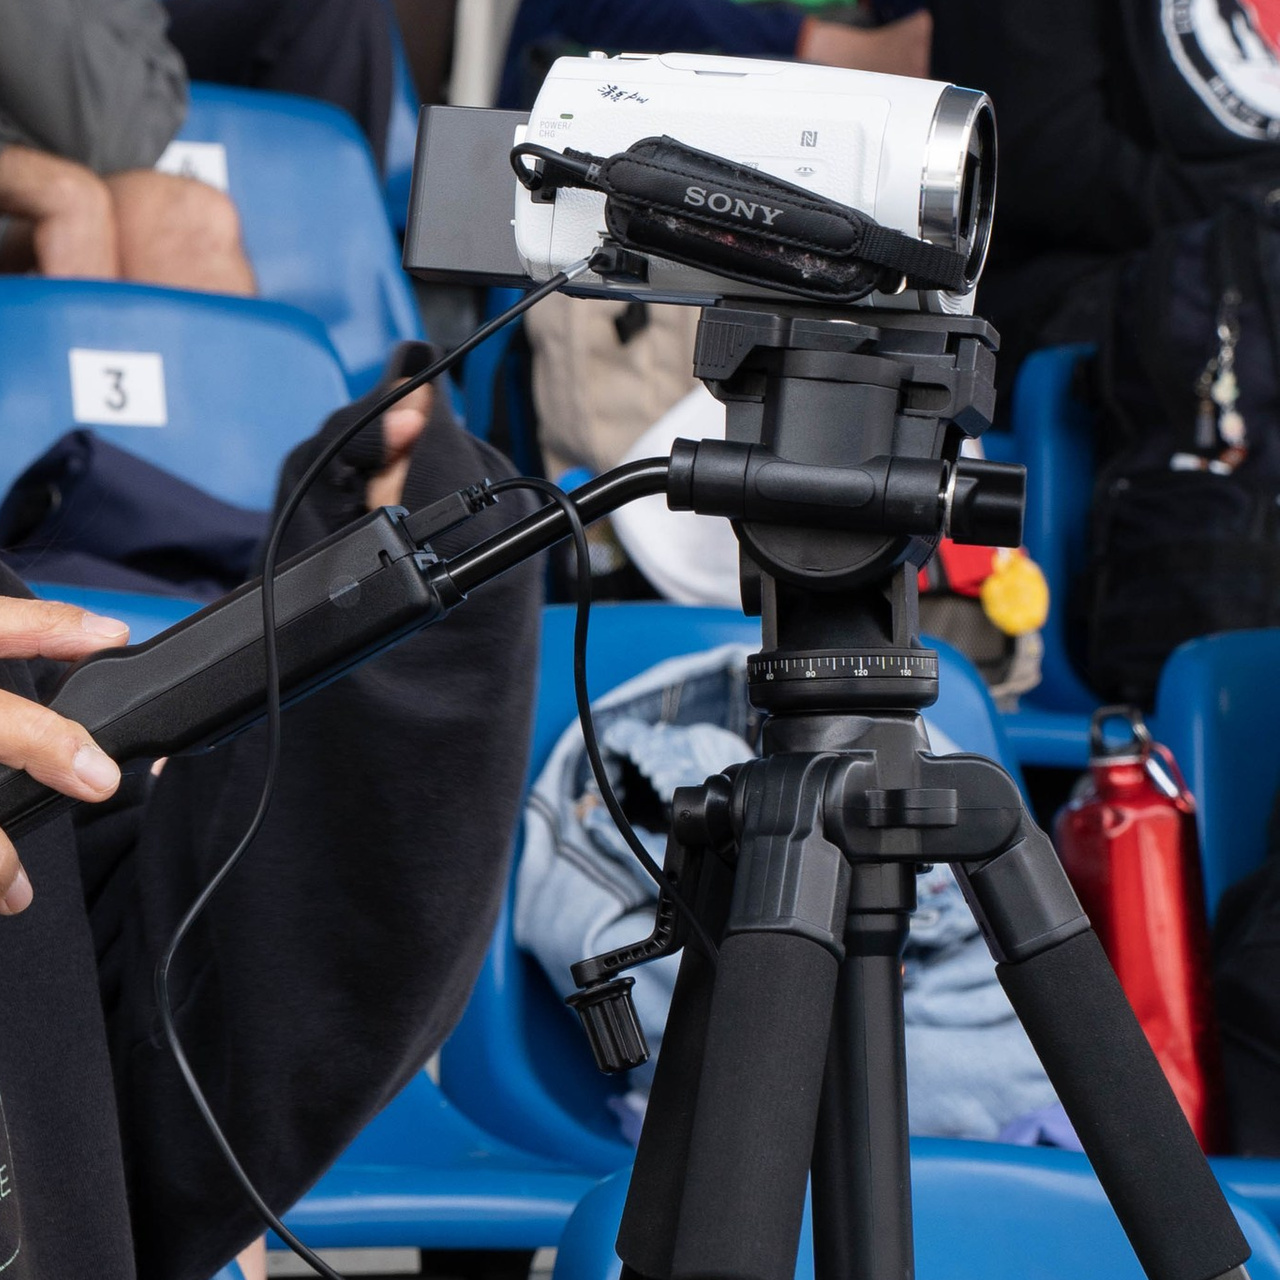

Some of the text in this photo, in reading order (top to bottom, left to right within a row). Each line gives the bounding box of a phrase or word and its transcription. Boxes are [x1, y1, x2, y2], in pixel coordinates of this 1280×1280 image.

[538, 129, 556, 138] CHG
[683, 186, 784, 226] SONY
[104, 368, 127, 412] 3
[805, 670, 816, 678] 90
[853, 668, 869, 677] 120
[900, 668, 912, 677] 150
